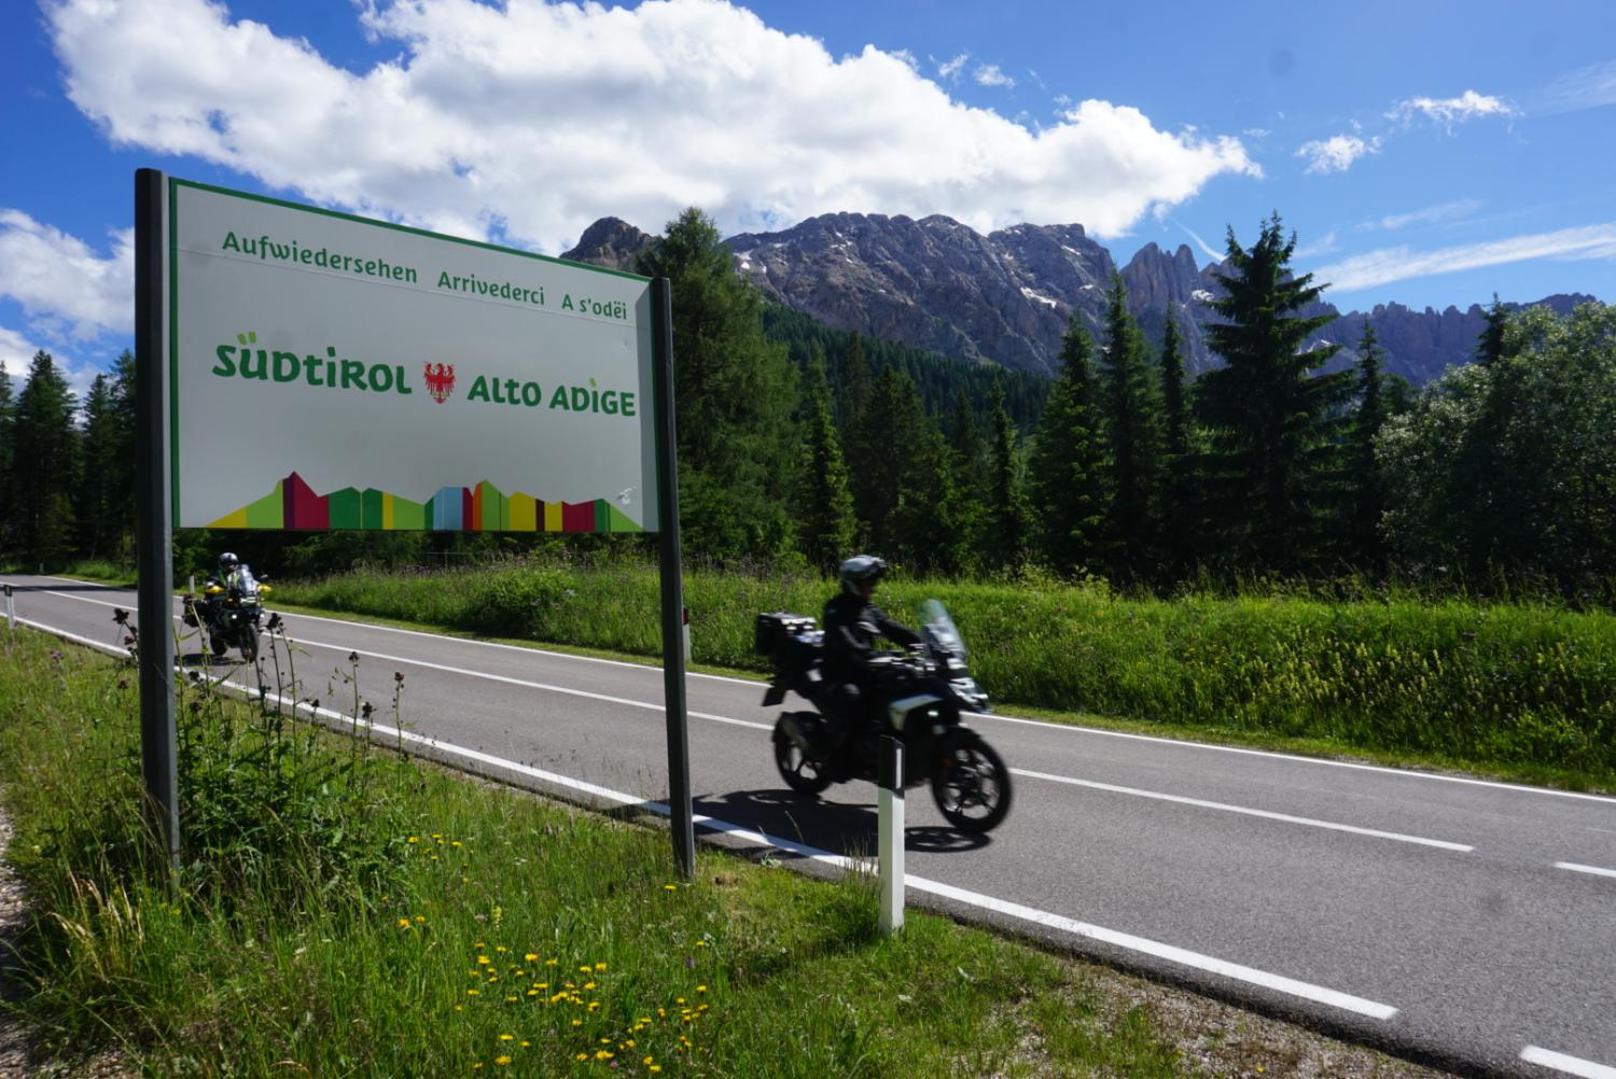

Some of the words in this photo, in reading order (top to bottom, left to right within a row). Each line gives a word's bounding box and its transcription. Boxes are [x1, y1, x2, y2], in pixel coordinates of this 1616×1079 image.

[222, 231, 417, 283] Aufwiedersehen
[437, 271, 545, 305] Arrivederci
[561, 294, 574, 310] A
